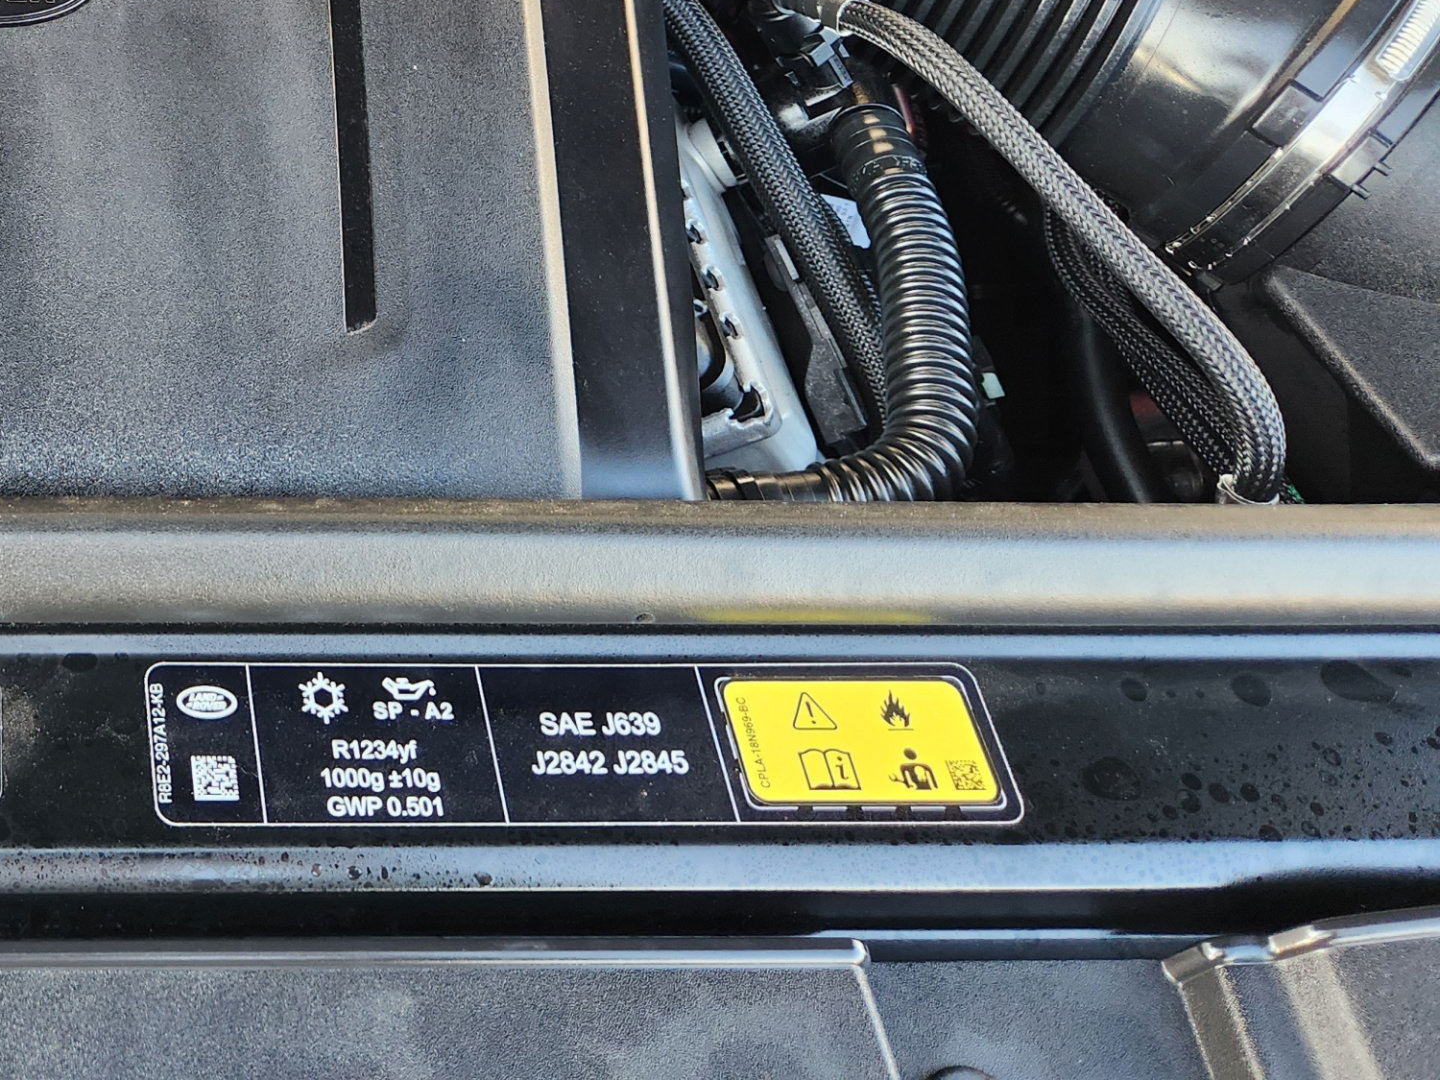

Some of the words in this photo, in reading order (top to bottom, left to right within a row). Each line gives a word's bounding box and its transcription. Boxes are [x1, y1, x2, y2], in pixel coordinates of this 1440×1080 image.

[372, 701, 403, 720] SP
[424, 701, 455, 721] A2
[539, 711, 593, 736] SAE
[601, 711, 662, 736] J639
[331, 739, 418, 763] R1234yf
[531, 749, 609, 775] J2842
[613, 749, 690, 775] J2845
[320, 767, 385, 793] 1000g
[387, 767, 442, 793] ±10g
[326, 795, 382, 817] GWP
[385, 795, 444, 817] 0.501
